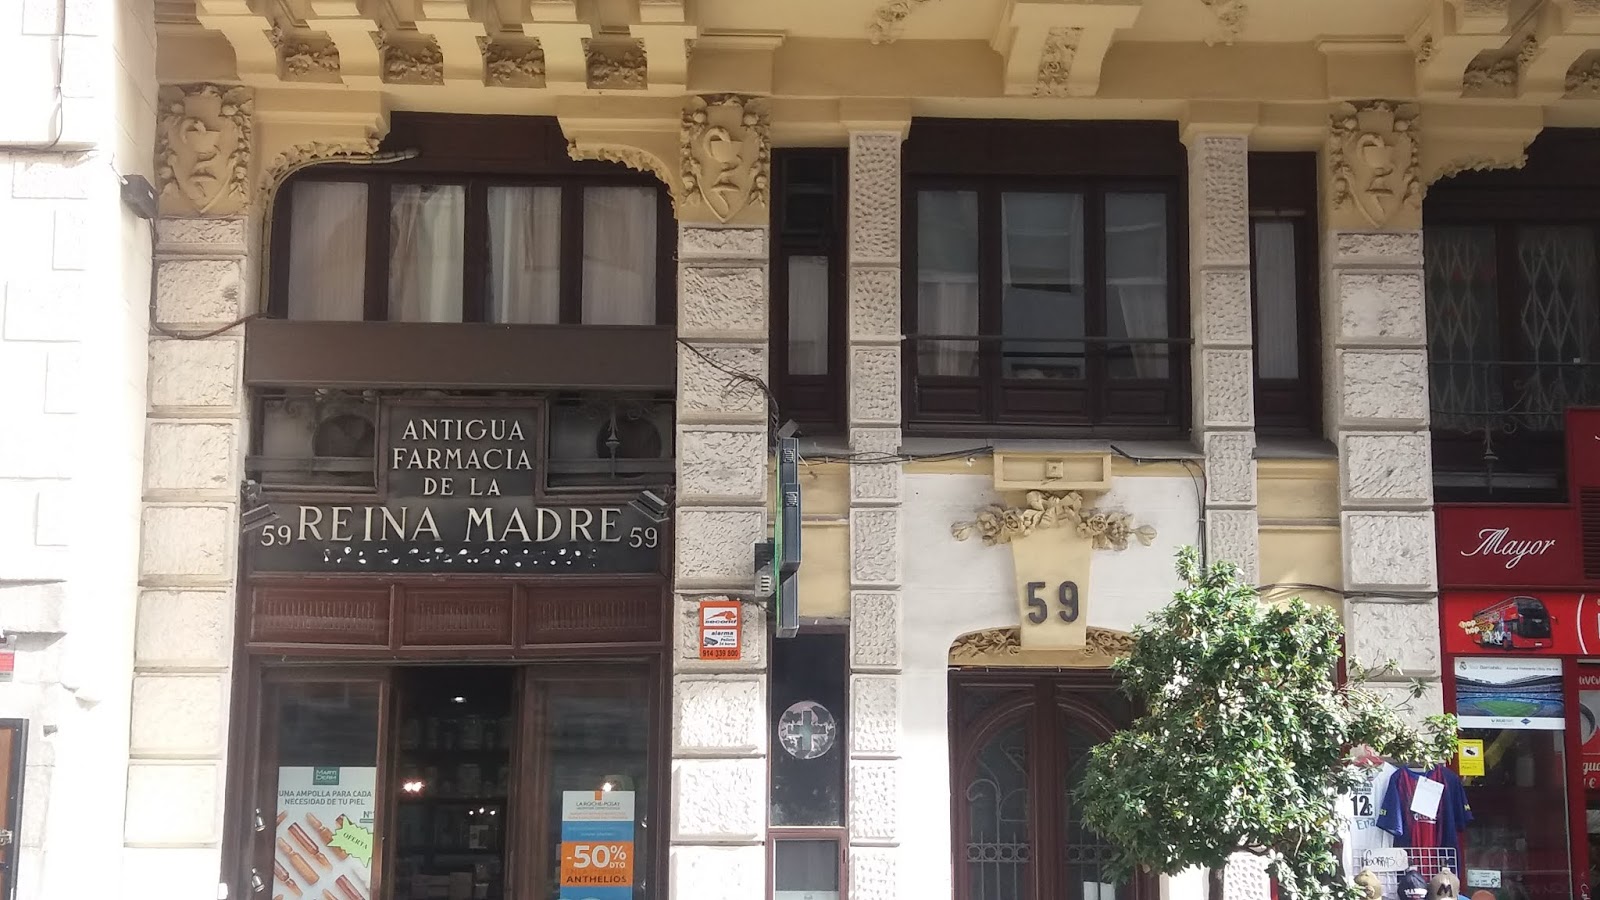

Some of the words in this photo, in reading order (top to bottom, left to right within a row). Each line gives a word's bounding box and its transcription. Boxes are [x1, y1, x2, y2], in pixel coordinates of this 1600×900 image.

[401, 419, 525, 441] ANTIGUA
[392, 448, 533, 470] FARMACIA
[424, 478, 454, 496] DE
[470, 478, 501, 496] LA
[260, 525, 291, 547] 59
[297, 506, 445, 542] REINA
[463, 507, 623, 543] MADRE
[629, 527, 659, 548] 59
[1461, 527, 1556, 569] Mayor
[1027, 581, 1079, 624] 59
[343, 832, 368, 850] OFERTA
[566, 845, 627, 868] -50%
